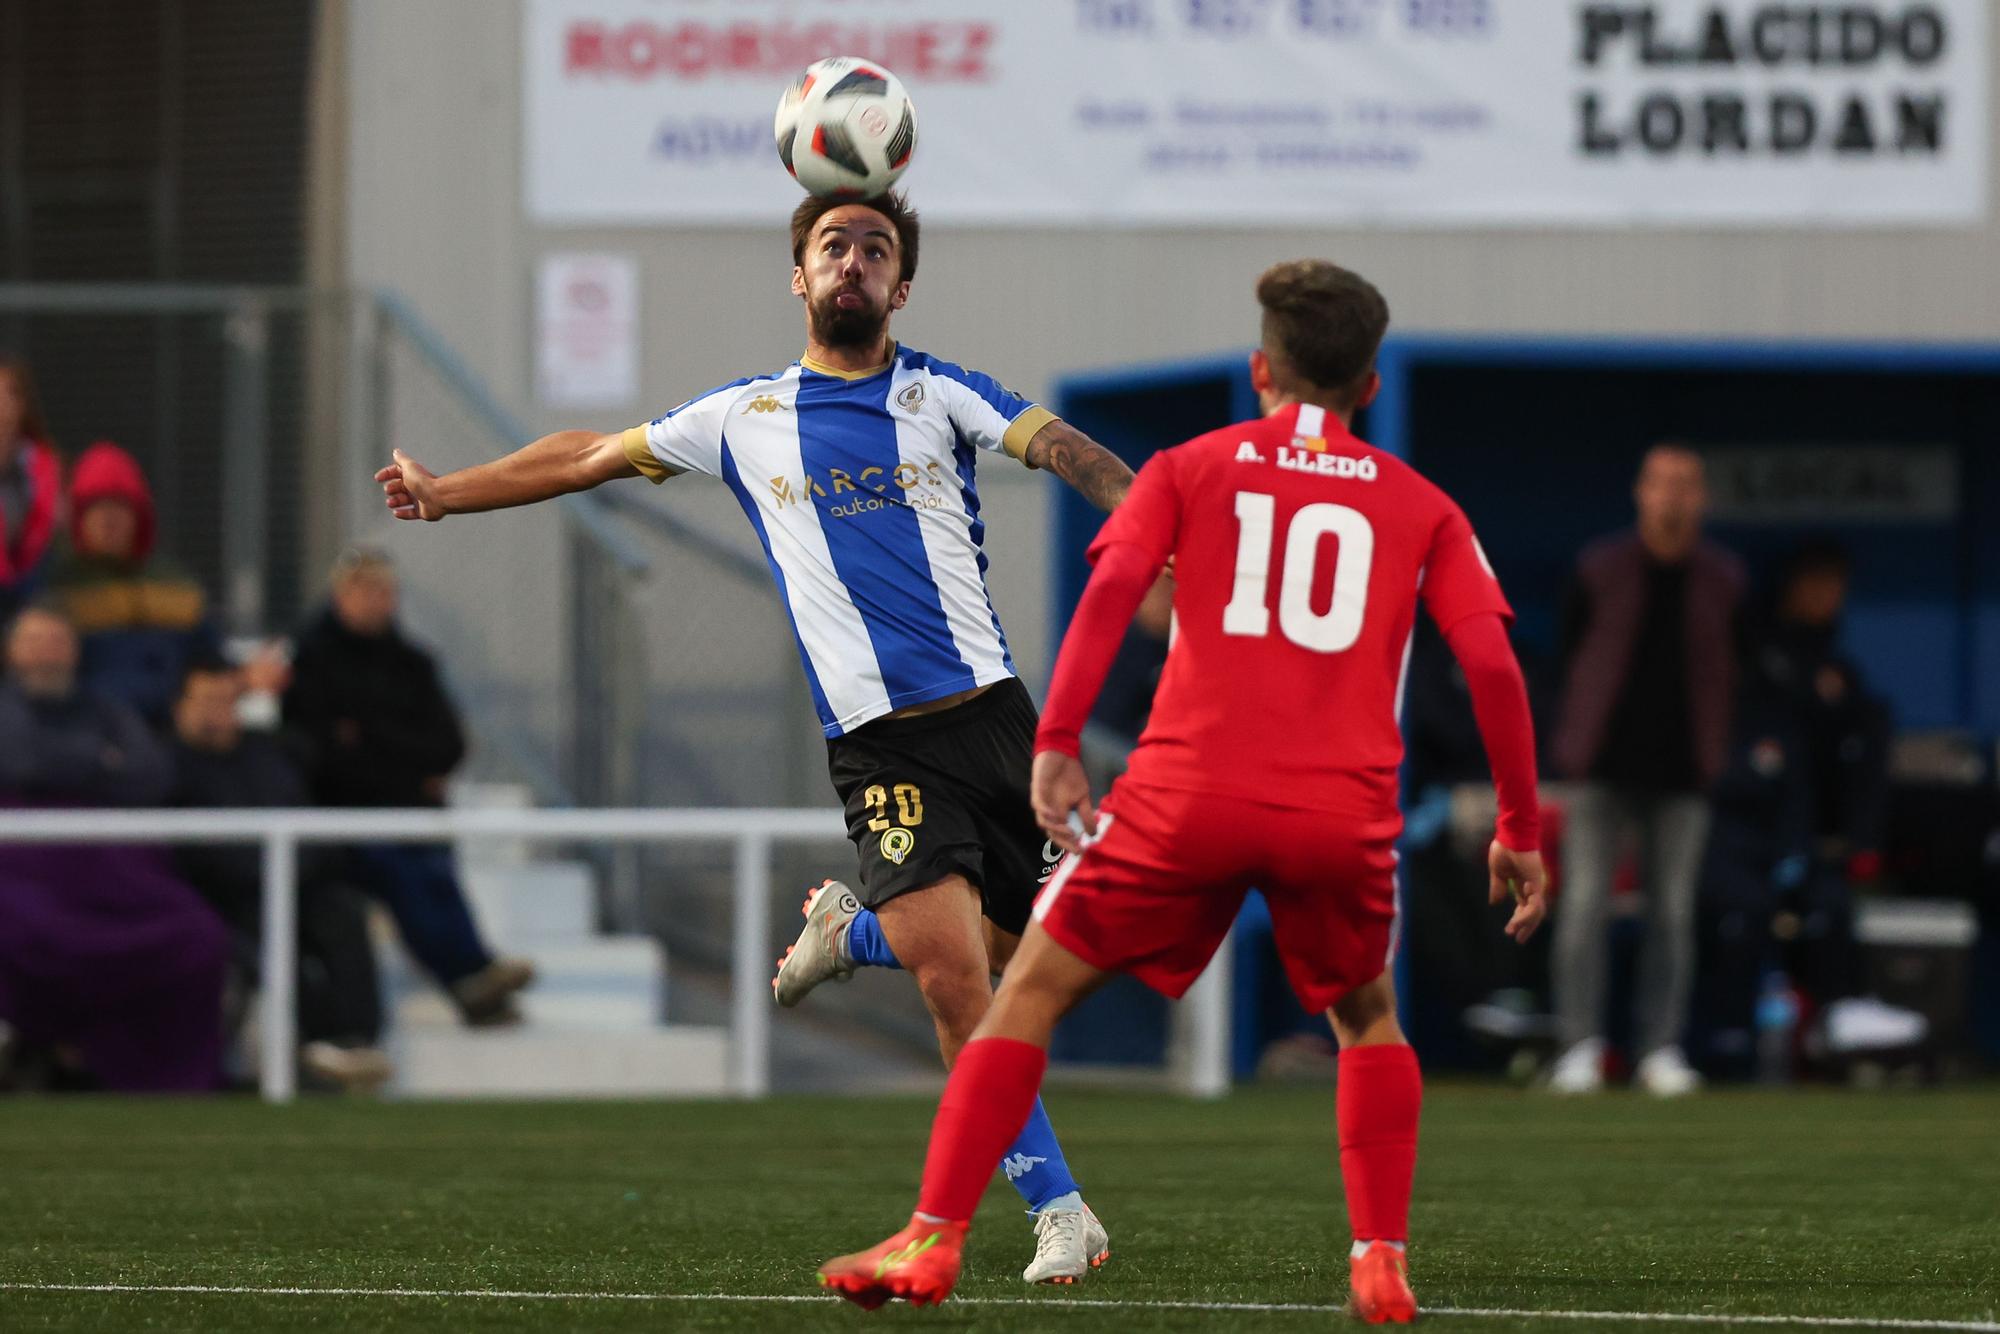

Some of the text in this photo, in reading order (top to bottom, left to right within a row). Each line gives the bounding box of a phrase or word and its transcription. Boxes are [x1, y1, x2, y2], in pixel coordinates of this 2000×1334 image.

[1577, 4, 1947, 66] PLACIDO
[1577, 93, 1947, 157] LORDAN
[1235, 442, 1377, 481] A. LLEDÓ
[1223, 491, 1374, 654] 10
[865, 783, 923, 832] 20
